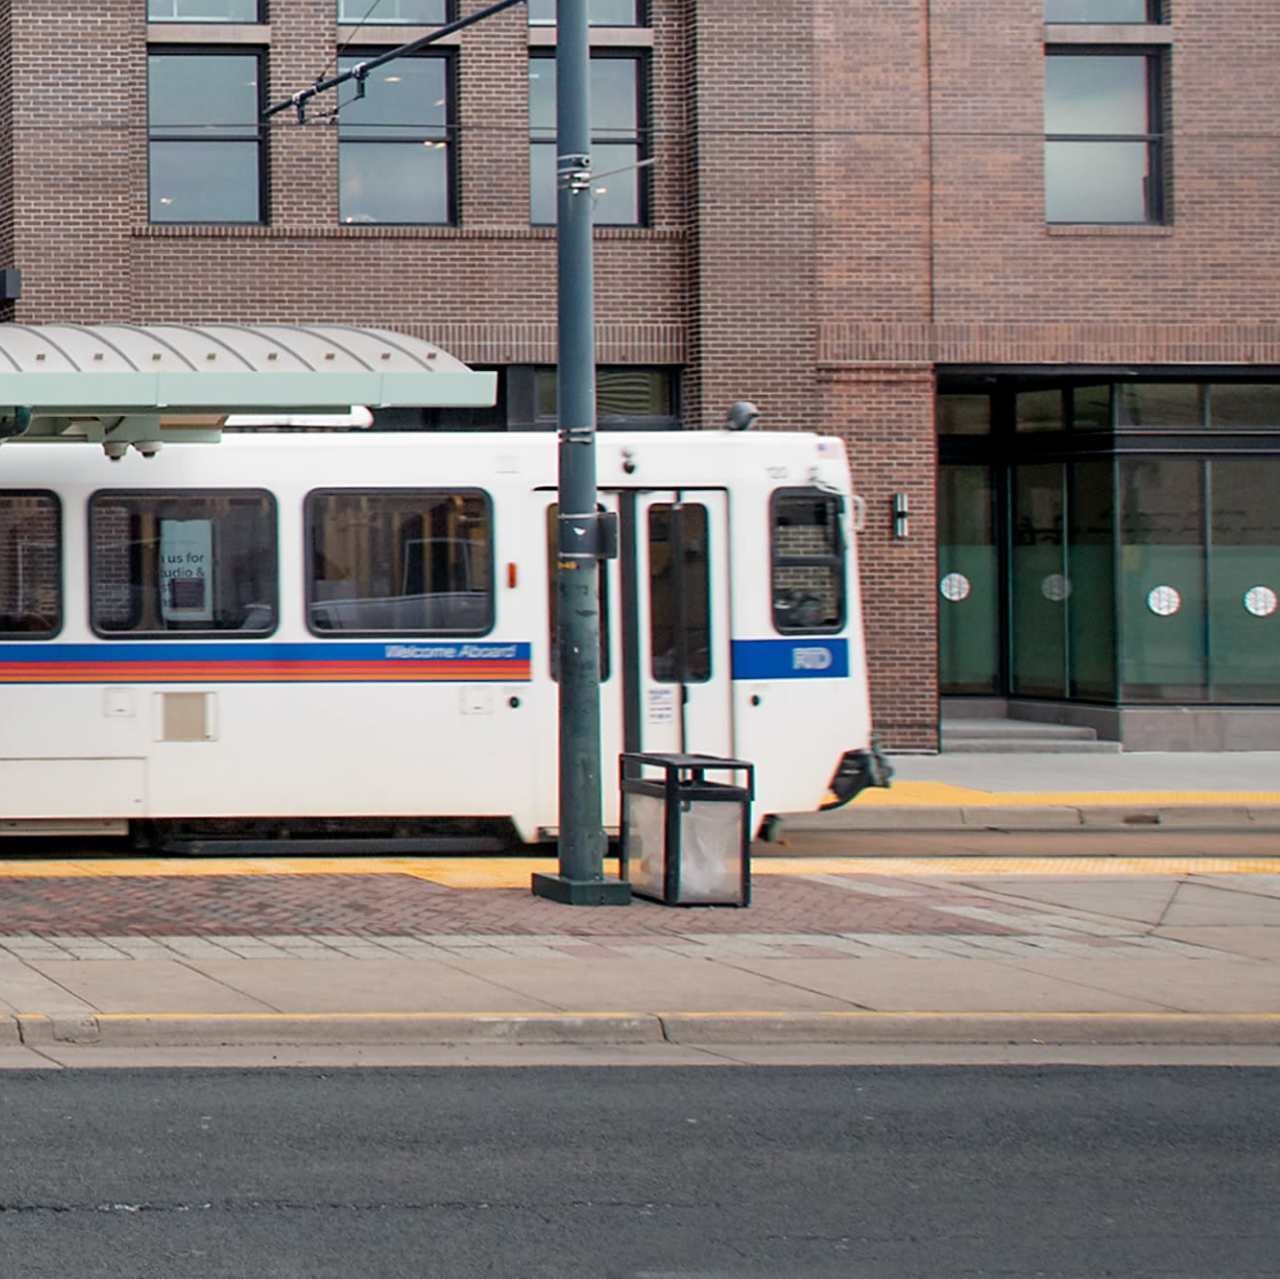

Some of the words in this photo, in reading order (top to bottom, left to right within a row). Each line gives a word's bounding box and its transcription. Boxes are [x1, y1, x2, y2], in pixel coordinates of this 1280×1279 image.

[167, 554, 183, 564] us
[186, 552, 205, 564] for
[384, 644, 456, 658] Welcome
[457, 644, 518, 658] Aboard
